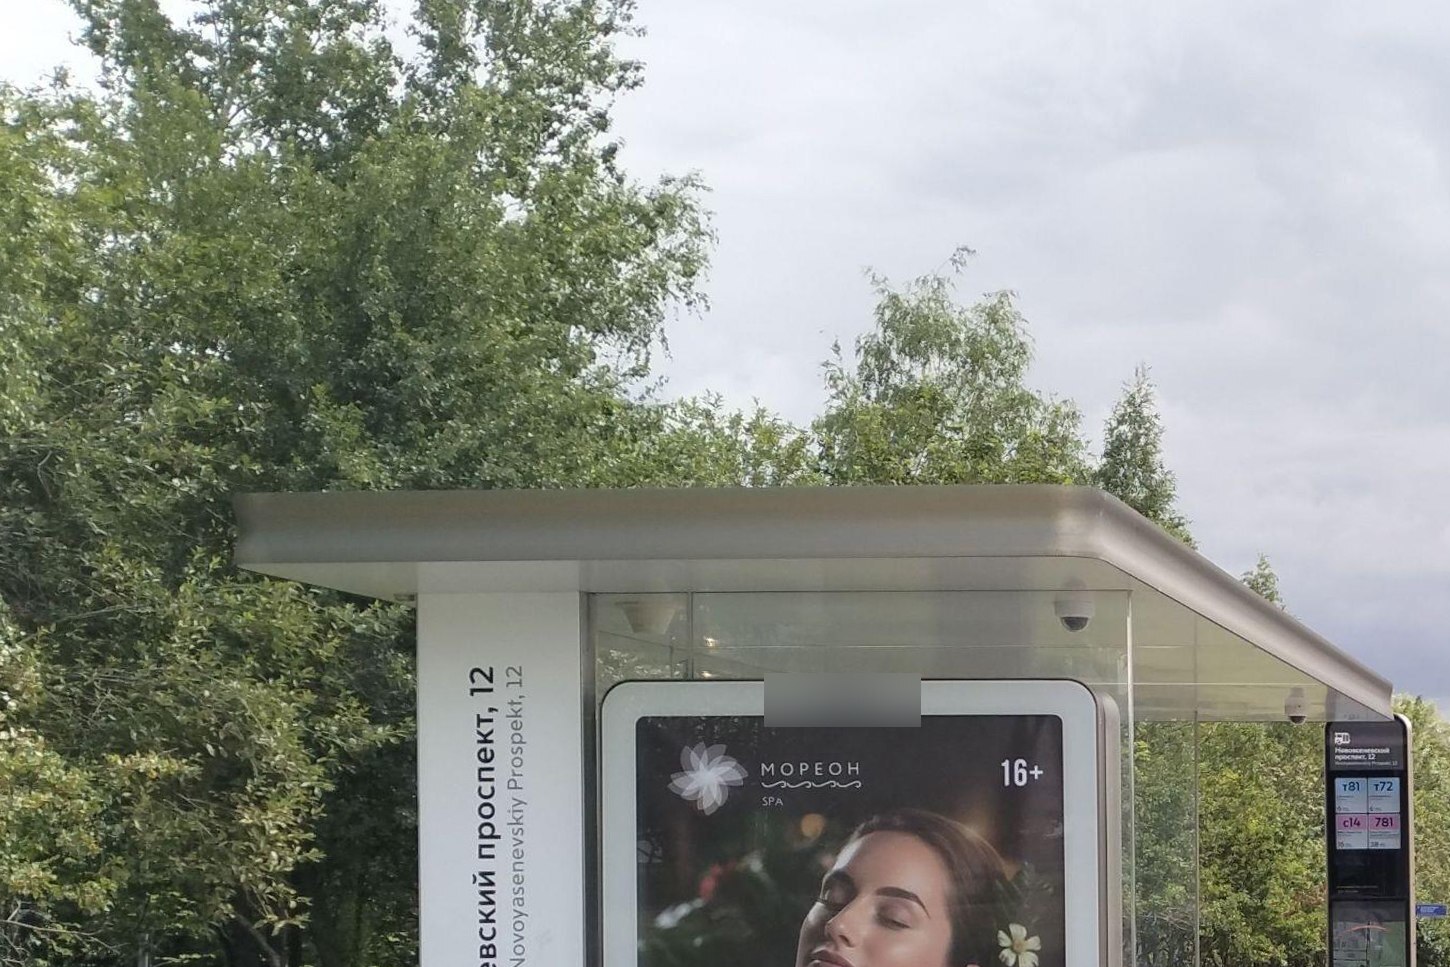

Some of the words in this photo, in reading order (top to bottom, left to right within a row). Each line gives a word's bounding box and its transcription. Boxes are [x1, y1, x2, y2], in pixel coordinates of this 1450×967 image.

[469, 666, 494, 697] 12
[506, 665, 522, 688] 12
[506, 695, 527, 790] Prospekt,
[761, 762, 859, 776] МОРЕОН
[1001, 758, 1043, 787] 16+
[476, 707, 501, 859] проспект,
[762, 797, 783, 806] SPA
[1375, 817, 1393, 827] 781
